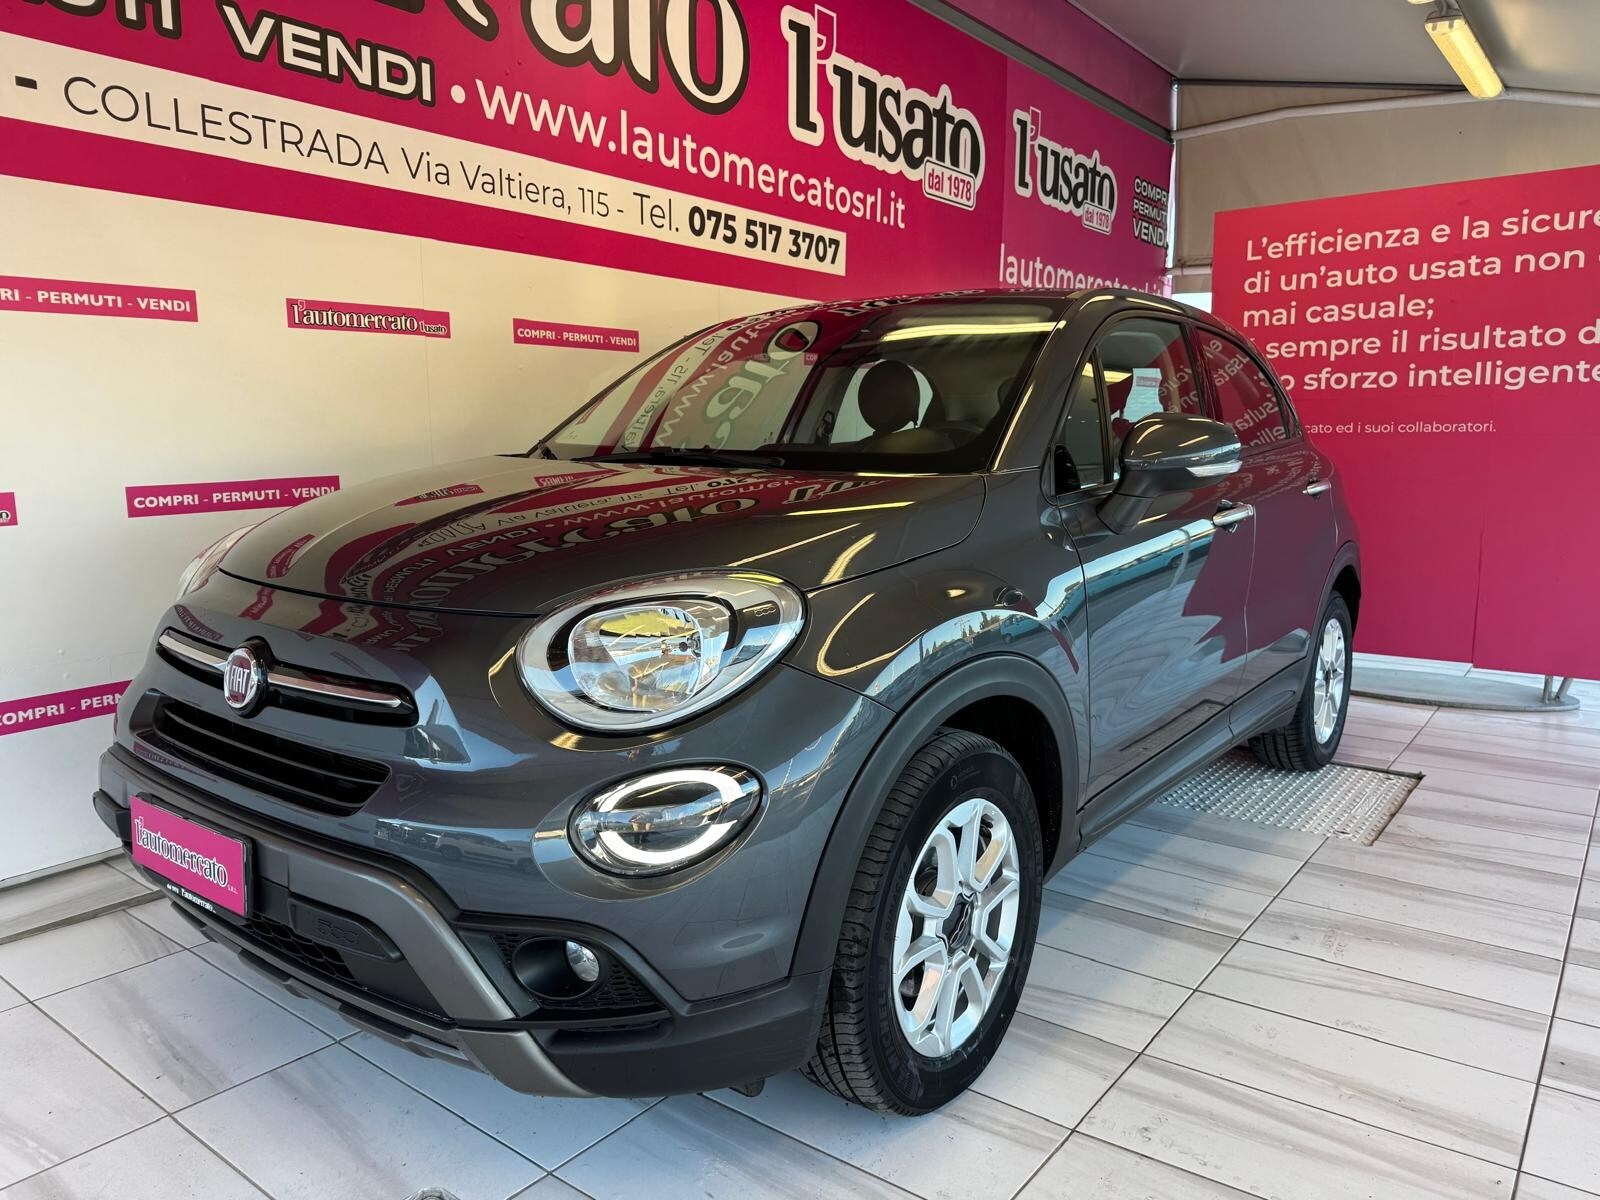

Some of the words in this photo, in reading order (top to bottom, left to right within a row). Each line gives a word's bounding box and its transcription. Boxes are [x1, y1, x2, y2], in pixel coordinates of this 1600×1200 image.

[222, 4, 434, 102] VENDI
[475, 78, 906, 229] www.lautomercatosrl.it
[64, 76, 390, 174] COLLESTRADA
[401, 146, 451, 187] Via
[459, 160, 572, 215] Valtiera,
[578, 186, 610, 218] 115
[632, 191, 679, 233] Tel.
[688, 204, 737, 245] 075
[744, 217, 782, 253] 517
[788, 229, 840, 265] 3707
[927, 168, 944, 193] dal
[947, 175, 972, 202] 1978
[1084, 206, 1095, 222] dal
[1095, 209, 1111, 231] 1978
[1246, 226, 1420, 261] L'efficienza
[1431, 222, 1451, 243] e
[1462, 215, 1490, 240] la
[1243, 269, 1271, 294] di
[1280, 263, 1398, 292] un'auto
[1408, 255, 1502, 281] usata
[1514, 249, 1585, 273] non
[37, 290, 123, 308] PERMUTI
[137, 297, 191, 312] VENDI
[291, 300, 418, 331] l'automercato
[1243, 301, 1297, 328] mai
[1305, 293, 1435, 324] casuale;
[517, 328, 556, 340] COMPRI
[563, 331, 604, 344] PERMUTI
[609, 336, 636, 347] VENDI
[1265, 335, 1382, 361] sempre
[1391, 329, 1408, 354] il
[1419, 324, 1567, 352] risultato
[1303, 367, 1398, 391] sforzo
[1335, 421, 1353, 433] ed
[1364, 421, 1395, 433] suoi
[1397, 419, 1497, 433] collaboratori.
[133, 494, 199, 508] COMPRI
[212, 489, 281, 504] PERMUTI
[229, 665, 250, 694] FIAT
[134, 815, 229, 889] l'automercato
